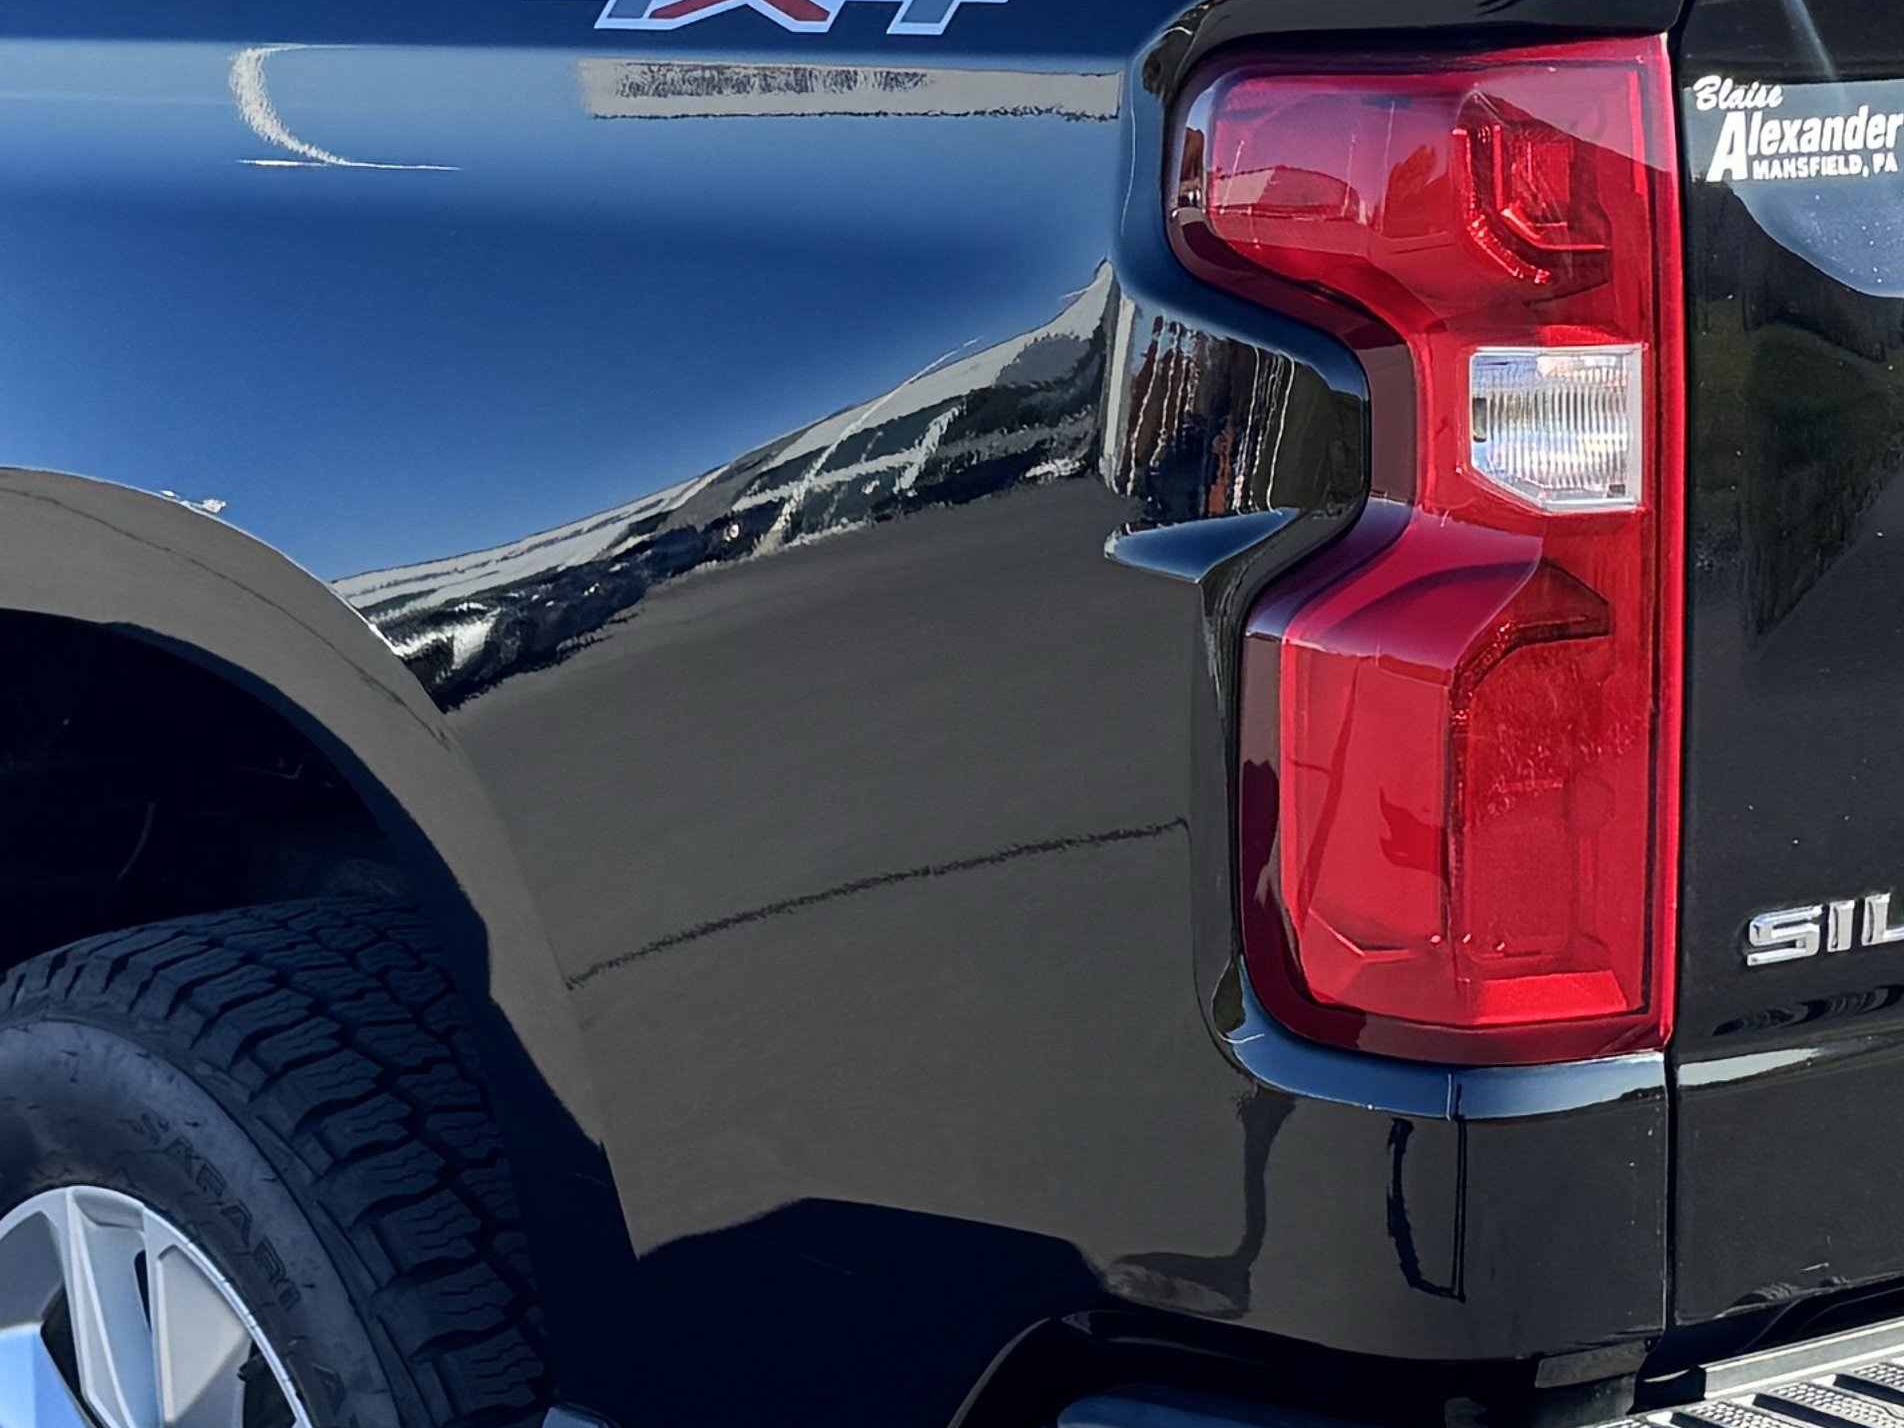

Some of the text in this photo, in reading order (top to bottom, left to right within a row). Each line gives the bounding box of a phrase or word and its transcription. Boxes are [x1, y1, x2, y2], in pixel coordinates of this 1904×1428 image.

[1693, 74, 1784, 112] Blaise
[1706, 104, 1904, 183] Alexander
[1752, 152, 1899, 181] MANSFIELD, PA
[128, 1109, 302, 1313] SAFARI
